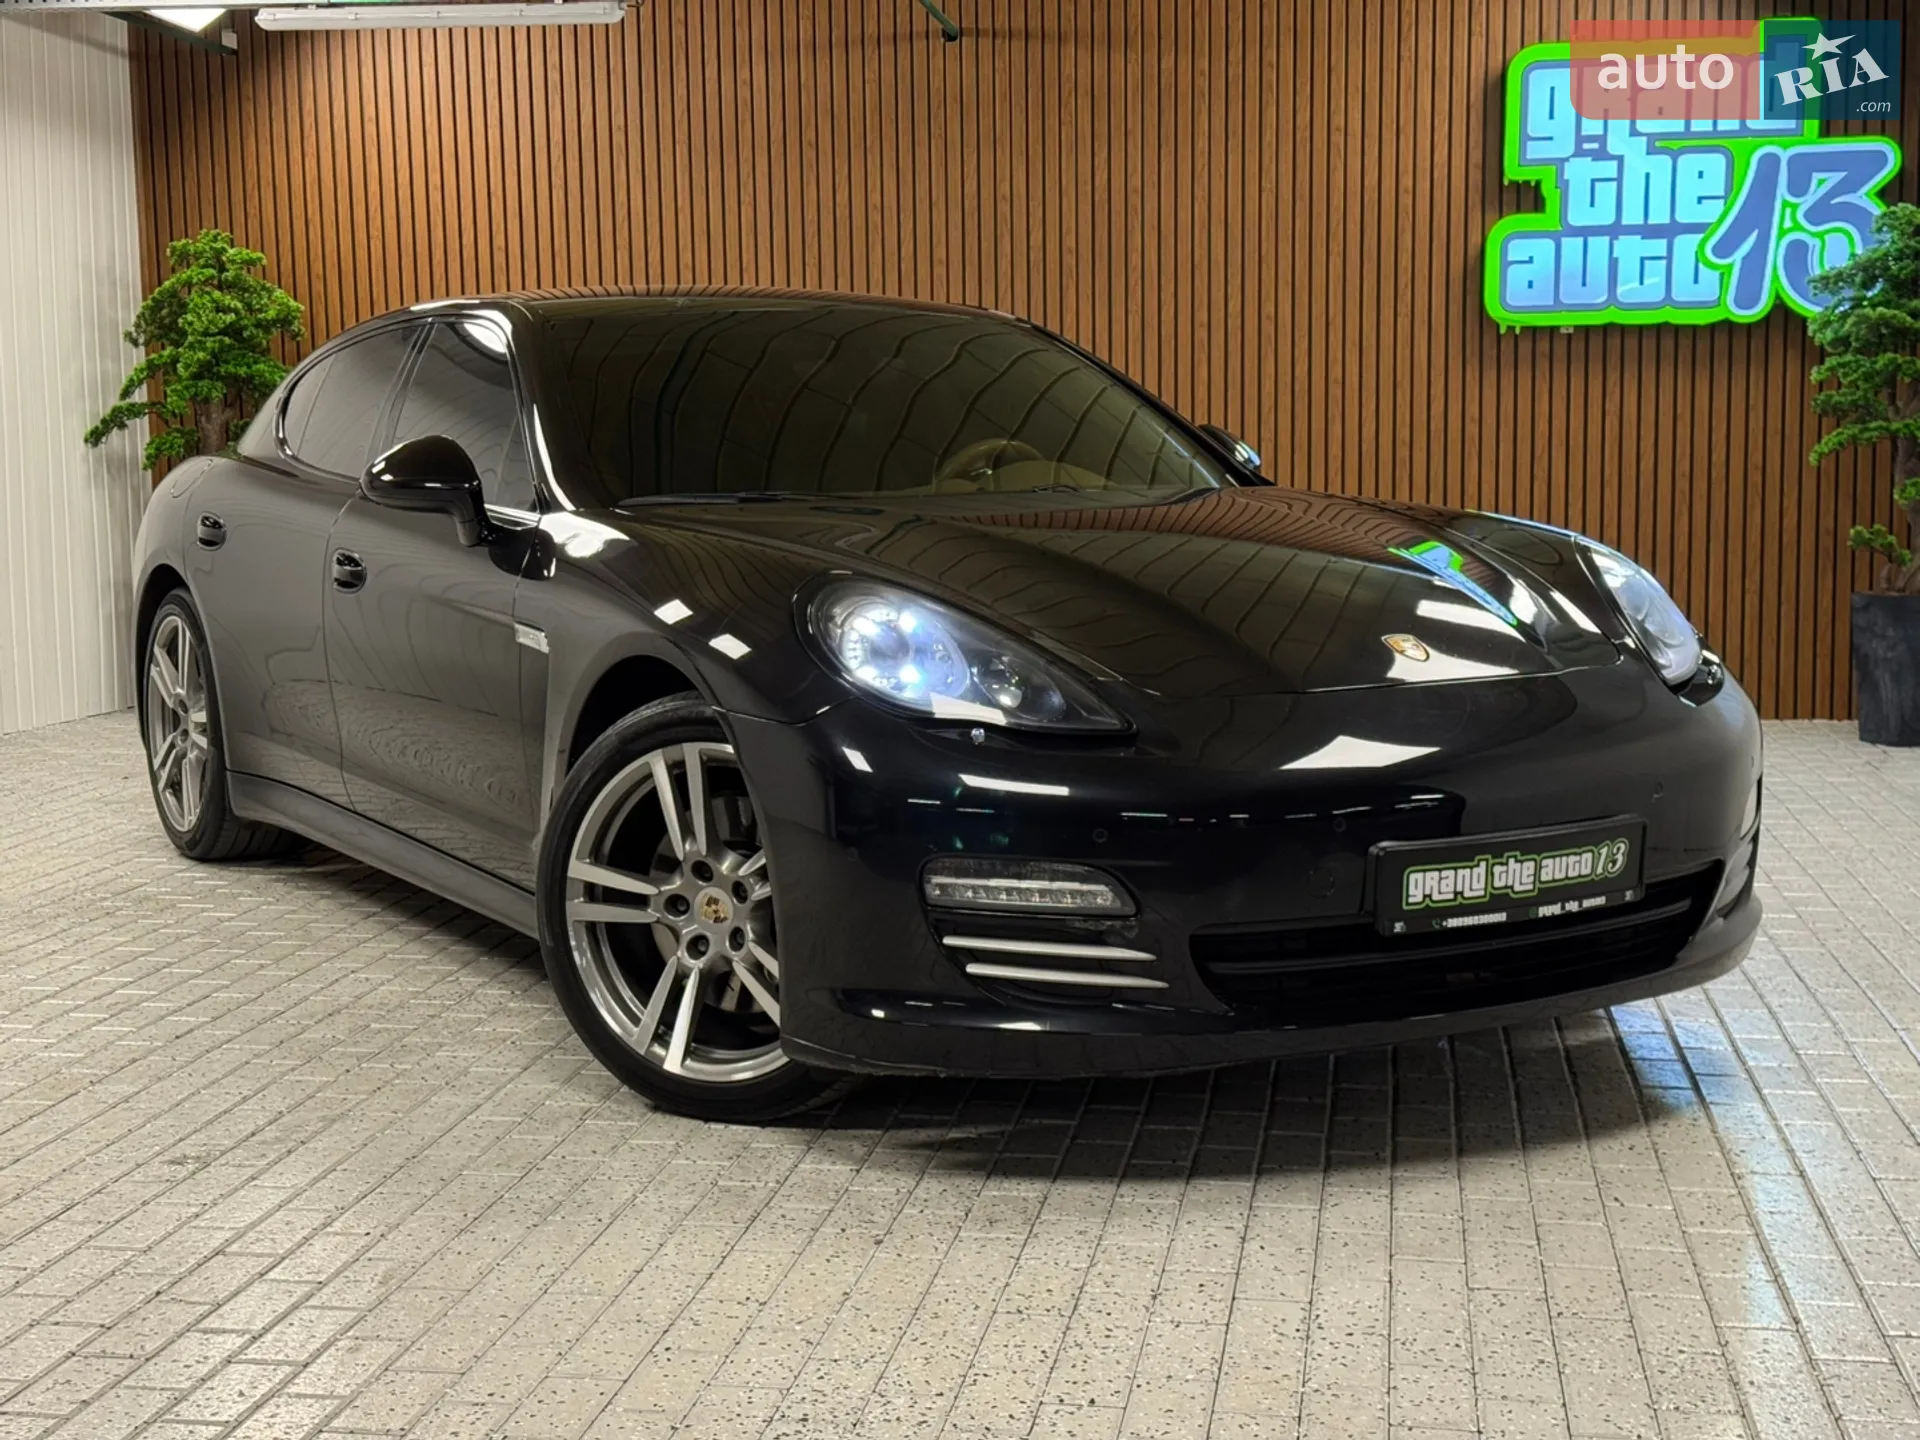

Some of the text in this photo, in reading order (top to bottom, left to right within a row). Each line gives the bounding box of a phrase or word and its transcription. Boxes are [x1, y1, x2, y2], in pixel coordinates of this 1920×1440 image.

[1564, 137, 1727, 227] the
[1506, 233, 1721, 307] auto
[1493, 858, 1535, 892] the
